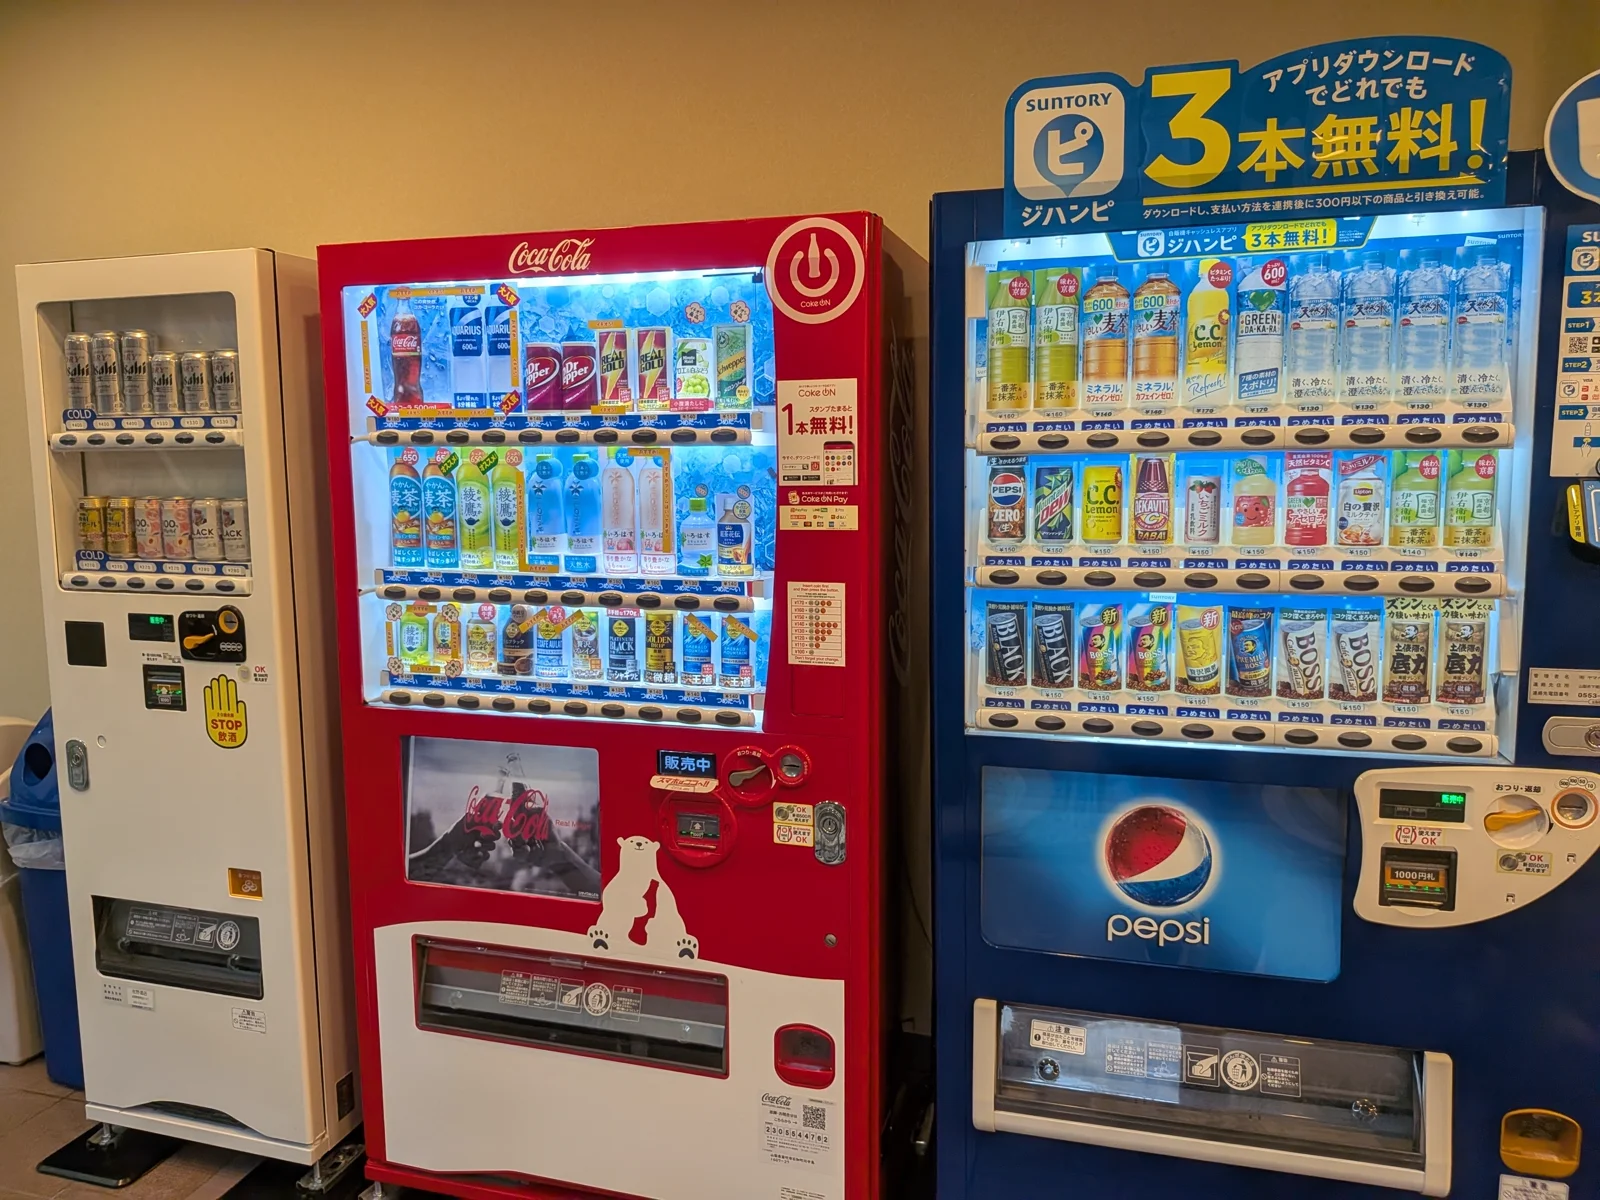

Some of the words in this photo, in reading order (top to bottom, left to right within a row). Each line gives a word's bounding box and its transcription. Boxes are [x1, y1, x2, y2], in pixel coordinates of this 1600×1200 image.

[1263, 49, 1475, 93] アプリダウンロード
[1306, 79, 1427, 107] でどれでも
[1025, 92, 1112, 112] SUNTORY
[1144, 67, 1487, 188] 3本無料!
[1046, 121, 1095, 175] ピ
[1143, 189, 1484, 219] ダウンロードし、支払い方法を連携後に300円以下の商品と引き換え可能。
[1021, 199, 1114, 227] ジハンピ
[1250, 221, 1327, 232] アプリダウンロードでどれでも
[1251, 226, 1328, 248] 3本無料!
[1146, 237, 1159, 252] ピ
[1167, 236, 1238, 254] ジハンピ
[508, 238, 596, 274] Coca-Cola
[1209, 268, 1232, 276] ビタミンC
[1264, 266, 1285, 278] 600
[1210, 275, 1231, 283] たっぷり!
[499, 287, 517, 304] 大人気
[1012, 287, 1027, 296] 京都
[1061, 285, 1076, 294] 京都
[360, 297, 377, 315] 大人気
[1092, 298, 1113, 311] 600
[1143, 296, 1164, 308] 600
[1465, 299, 1498, 315] 天然水
[1300, 305, 1332, 319] 天然水
[1354, 304, 1386, 317] 天然水
[1409, 302, 1441, 316] 天然水
[1103, 312, 1130, 335] 麦茶
[1153, 310, 1180, 333] 麦茶
[1245, 313, 1277, 325] GREEN
[1567, 320, 1589, 330] STEP1
[1194, 324, 1223, 341] C.C.
[1192, 340, 1222, 350] Lemon
[601, 351, 624, 364] REAL
[640, 351, 663, 364] REAL
[529, 361, 540, 371] Dr
[566, 360, 579, 371] Dr
[601, 360, 625, 375] GOLD
[640, 360, 664, 375] GOLD
[1564, 359, 1588, 369] STEP2
[1241, 371, 1277, 382] 7種の素材の
[1087, 384, 1123, 394] ミネラル!
[1136, 382, 1174, 392] ミネラル!
[1190, 376, 1227, 397] Refresh!
[1240, 378, 1278, 391] スポドリ!
[1403, 384, 1442, 396] 澄んでいる。
[1459, 383, 1499, 396] 澄んでいる。
[798, 388, 821, 397] Coke
[1136, 391, 1174, 401] カフェインゼロ!
[1293, 387, 1331, 398] 澄んでいる。
[1348, 385, 1386, 397] 澄んでいる。
[672, 400, 704, 408] 小腹満たしに
[1086, 393, 1123, 403] カフェインゼロ!
[369, 400, 386, 417] 大人気
[502, 396, 518, 413] 大人気
[809, 404, 853, 413] スタンプたまると
[67, 409, 91, 420] COLD
[1561, 407, 1584, 418] STEP3
[781, 402, 853, 436] 1本無料!
[1187, 421, 1223, 429] つめたい
[1085, 423, 1121, 431] つめたい
[1135, 422, 1171, 430] つめたい
[403, 454, 418, 463] 650
[506, 454, 519, 463] 650
[1288, 458, 1330, 468] 天然ビタミンC
[1424, 468, 1438, 477] 京都
[1479, 467, 1494, 476] 京都
[992, 485, 1022, 495] PEPSI
[1087, 484, 1119, 505] C.C.
[391, 489, 419, 507] 麦茶
[425, 489, 453, 507] 麦茶
[463, 487, 478, 517] 綾鷹
[498, 487, 513, 517] 綾鷹
[801, 495, 820, 503] Coke
[833, 495, 848, 504] Pay
[1085, 505, 1118, 515] Lemon
[1343, 502, 1380, 512] 白の贅沢
[993, 509, 1021, 522] ZERO
[1143, 512, 1161, 525] C
[1197, 494, 1207, 536] いちごミルク
[1289, 513, 1326, 525] アセロラ
[80, 551, 104, 561] COLD
[1387, 597, 1438, 611] ズシンとくる
[1441, 597, 1493, 611] ズシンとくる
[1102, 608, 1118, 624] 新
[1151, 607, 1166, 624] 新
[1203, 611, 1218, 628] 新
[1231, 610, 1272, 620] 最高峰のコク
[646, 635, 672, 644] GOLDEN
[610, 641, 634, 651] BLACK
[996, 621, 1025, 682] BLACK
[1041, 621, 1072, 684] BLACK
[1089, 648, 1113, 660] BOSS
[1138, 648, 1162, 660] BOSS
[1236, 651, 1267, 664] PREMIUM
[1244, 661, 1263, 669] BOSS
[1296, 632, 1322, 697] BOSS
[1349, 631, 1376, 698] BOSS
[1390, 653, 1427, 675] 底力
[1444, 653, 1482, 675] 底力
[653, 673, 675, 683] 微糖
[692, 674, 712, 685] 王道
[730, 676, 751, 687] 王道
[211, 719, 243, 731] STOP
[218, 731, 237, 743] 飲酒
[664, 755, 711, 773] 販売中
[1495, 783, 1542, 794] おつり・返却
[1441, 794, 1464, 805] 販売中
[796, 806, 807, 814] OK
[795, 835, 807, 844] OK
[1418, 830, 1442, 838] 使えます
[1421, 837, 1437, 846] OK
[1529, 854, 1544, 862] OK
[1394, 870, 1436, 881] 1000円札
[1107, 914, 1210, 947] pepsi
[761, 1092, 792, 1107] Coca-Cola
